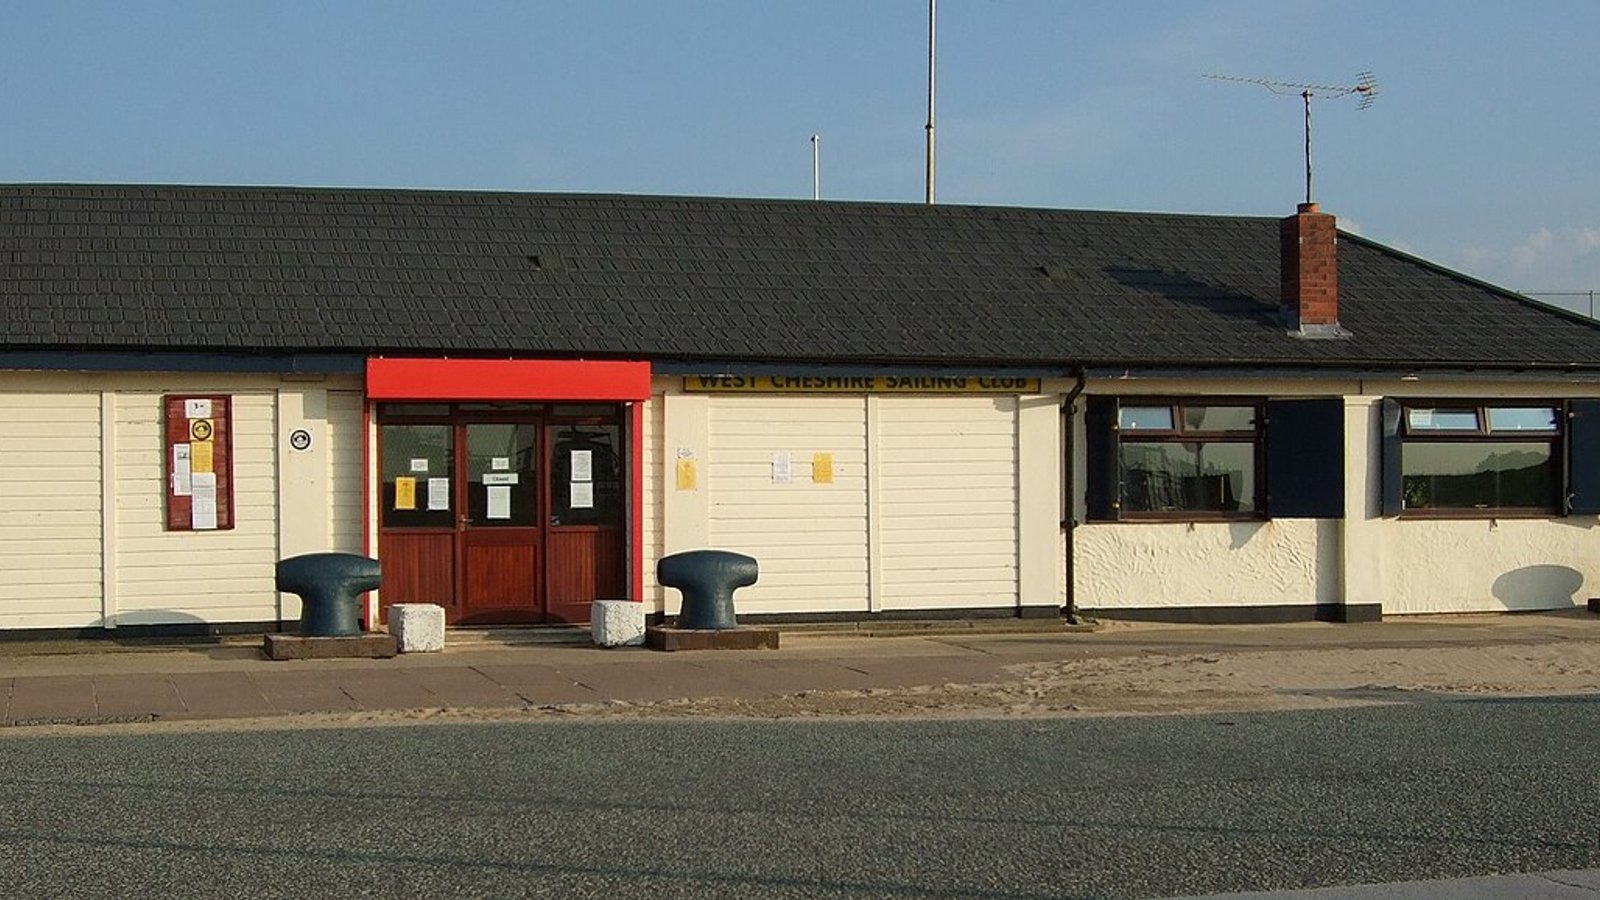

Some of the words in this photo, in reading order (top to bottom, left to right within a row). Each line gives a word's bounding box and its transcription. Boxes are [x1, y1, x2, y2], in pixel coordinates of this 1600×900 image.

[700, 376, 756, 389] WEST
[770, 376, 875, 389] CHESHIRE
[886, 376, 967, 389] SAILING
[979, 377, 1027, 389] CLUB
